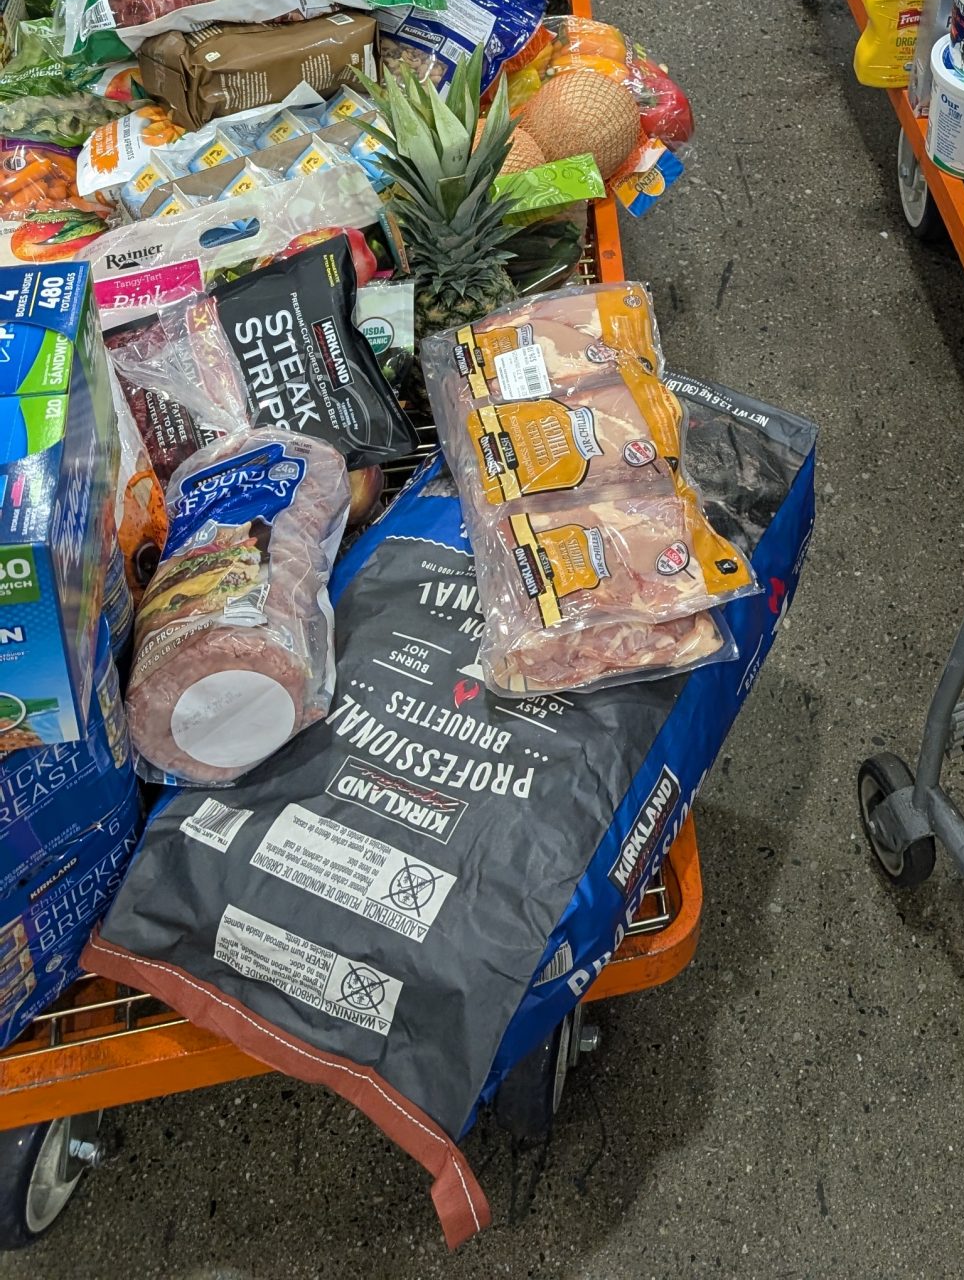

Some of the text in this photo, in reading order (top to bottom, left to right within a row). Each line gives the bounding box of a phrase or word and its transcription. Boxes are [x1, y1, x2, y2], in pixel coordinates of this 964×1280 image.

[403, 24, 443, 45] KIRKLAND
[940, 92, 961, 110] Our
[106, 242, 165, 271] Rainier
[15, 272, 35, 318] BOXES INSIDE
[38, 276, 65, 310] 480
[60, 272, 76, 313] TOTAL BAGS
[113, 272, 163, 290] Tangy-Tart
[320, 320, 350, 385] KIRKLAND
[362, 326, 386, 337] USDA
[265, 308, 322, 431] STEAK
[45, 399, 63, 420] 120
[501, 436, 516, 467] FRESH
[528, 419, 545, 468] CHICKEN
[540, 415, 572, 462] THIGHS
[573, 411, 597, 455] AIR-CHILLED
[513, 547, 538, 597] KIRKLAND
[388, 650, 430, 674] BURNS
[402, 643, 430, 659] HOT
[385, 691, 513, 754] BRIQUETTES
[325, 693, 535, 799] PROFESSIONAL
[337, 774, 451, 836] KIRKLAND
[613, 776, 674, 889] KIRKLAND
[30, 858, 78, 900] KIRKLAND
[34, 828, 139, 933] CHICKEN
[362, 897, 417, 939] ADVERTENCIA
[215, 949, 321, 1007] CARBON MONOXIDE HAZARD
[324, 1000, 376, 1030] WARNING
